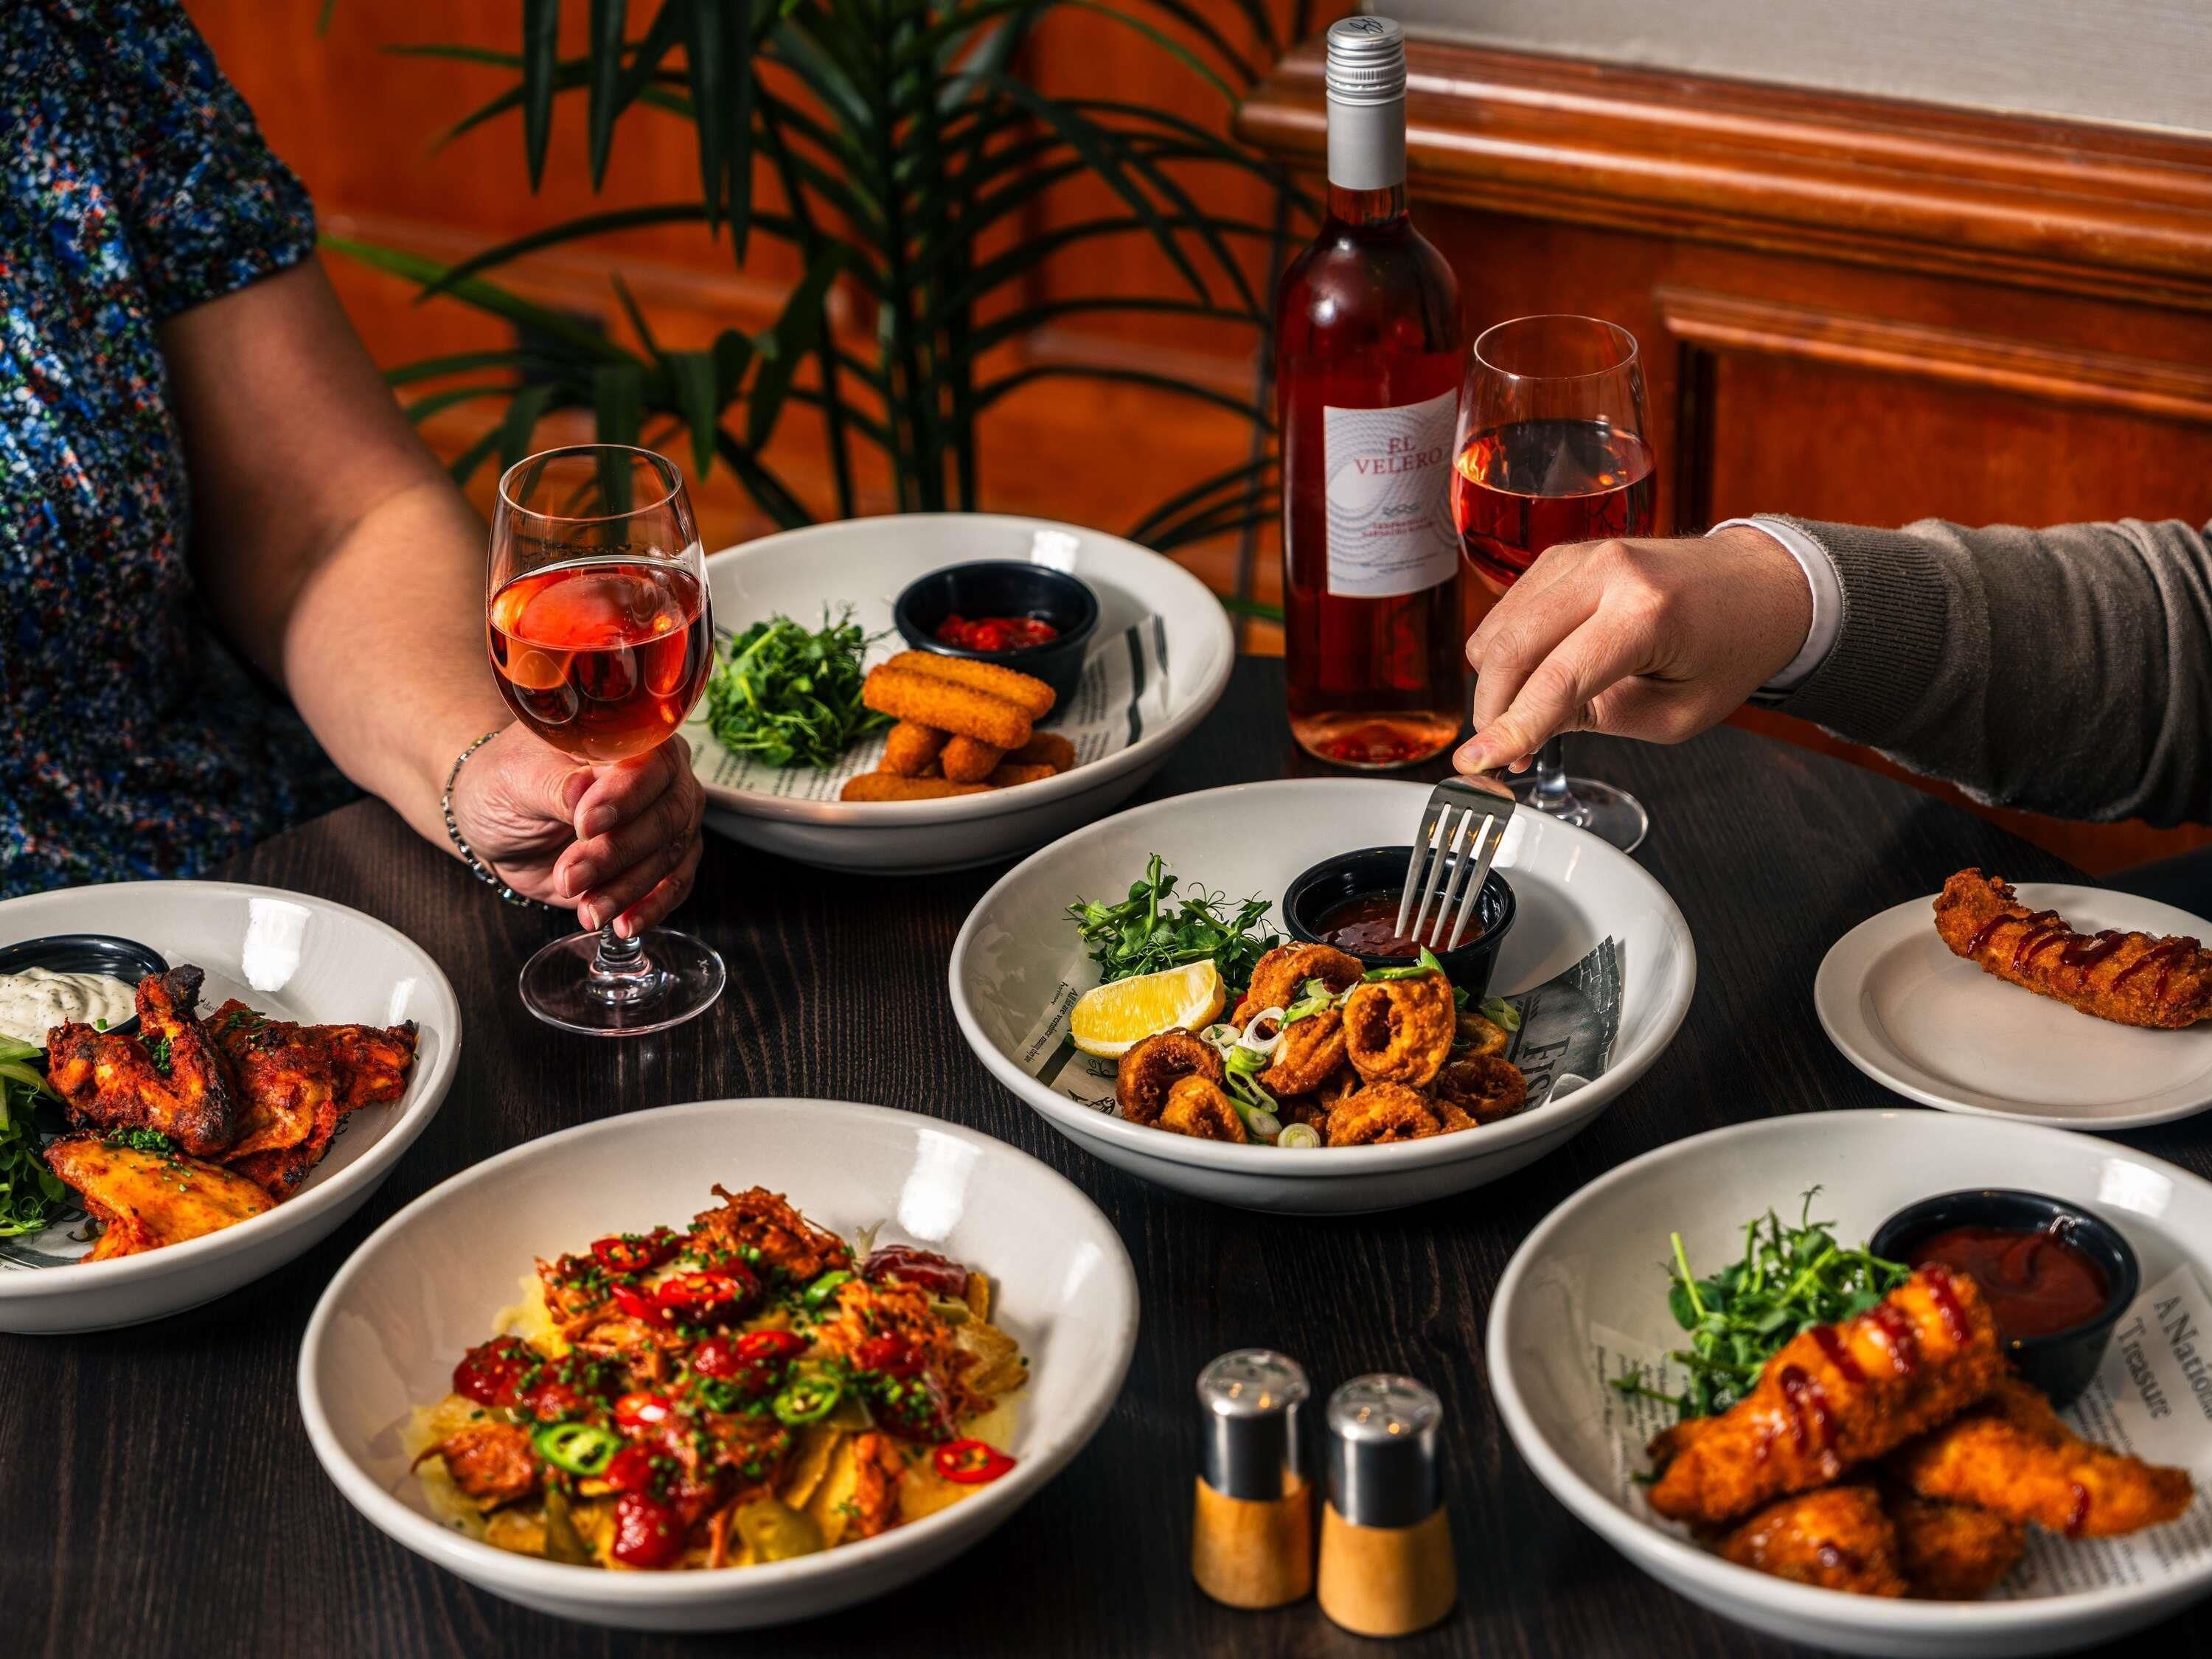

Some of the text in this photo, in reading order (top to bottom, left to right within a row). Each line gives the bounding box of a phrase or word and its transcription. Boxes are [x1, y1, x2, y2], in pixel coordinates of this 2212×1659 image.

[1389, 436, 1416, 453] EL
[1354, 447, 1443, 474] VELERO
[1519, 1037, 1571, 1104] FIS
[2153, 1295, 2182, 1321] A
[2118, 1316, 2172, 1420] Treasure
